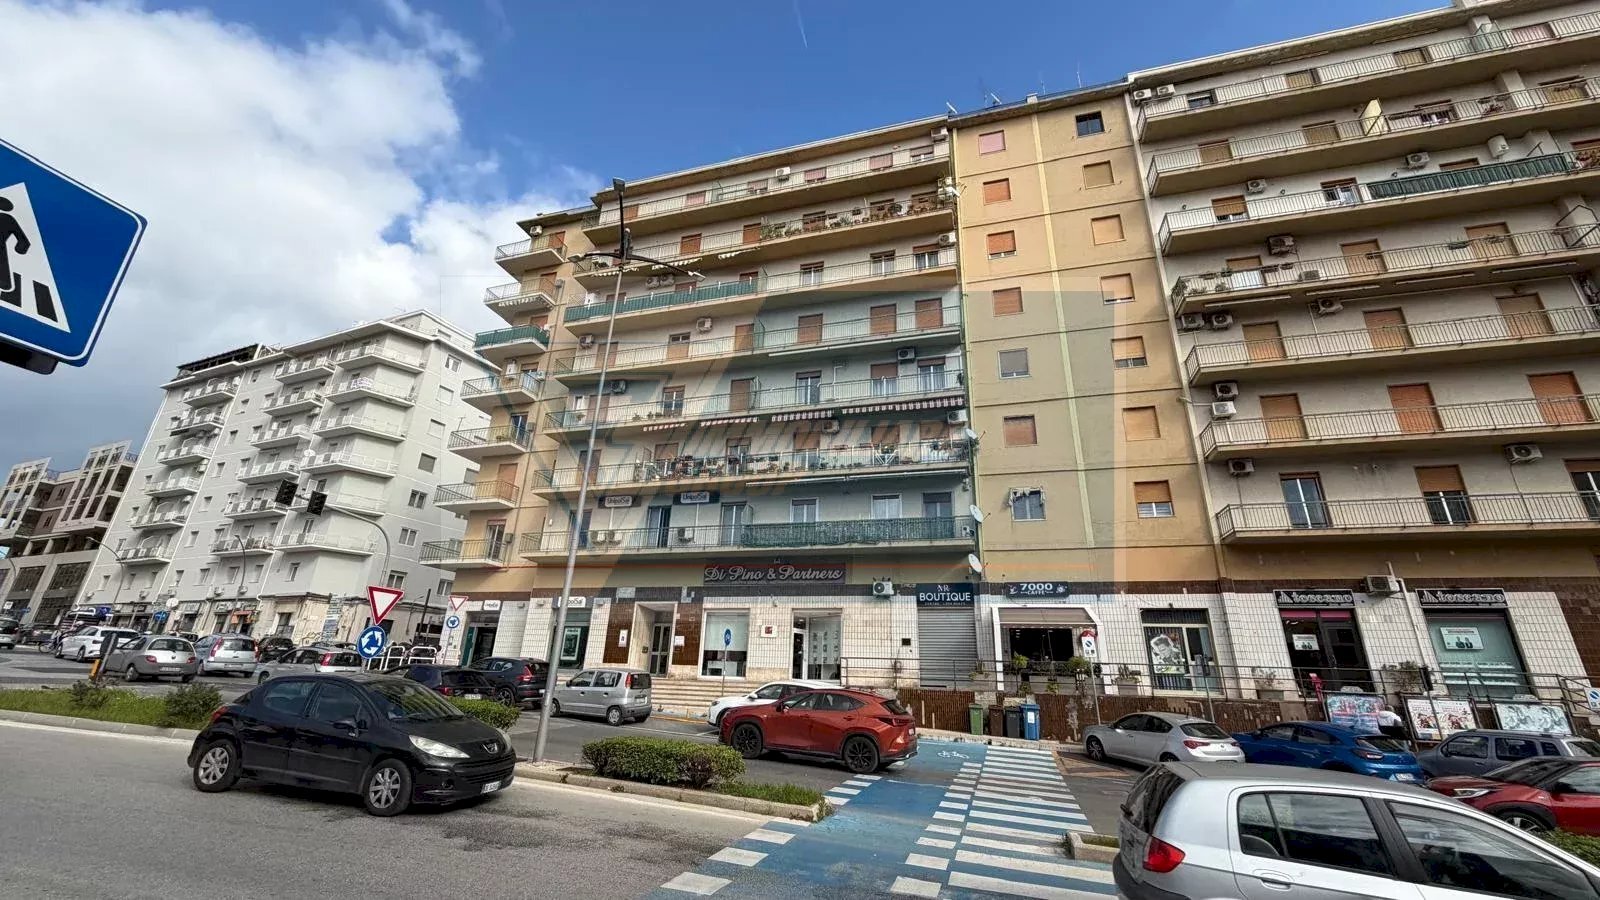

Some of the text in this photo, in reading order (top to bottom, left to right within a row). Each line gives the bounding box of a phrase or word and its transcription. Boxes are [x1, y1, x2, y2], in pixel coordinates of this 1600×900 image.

[729, 565, 764, 580] Pino
[767, 569, 776, 579] &
[779, 564, 843, 580] Partners
[1020, 583, 1053, 591] 7000
[919, 592, 971, 602] BOUTIQUE
[1436, 590, 1505, 603] toscano
